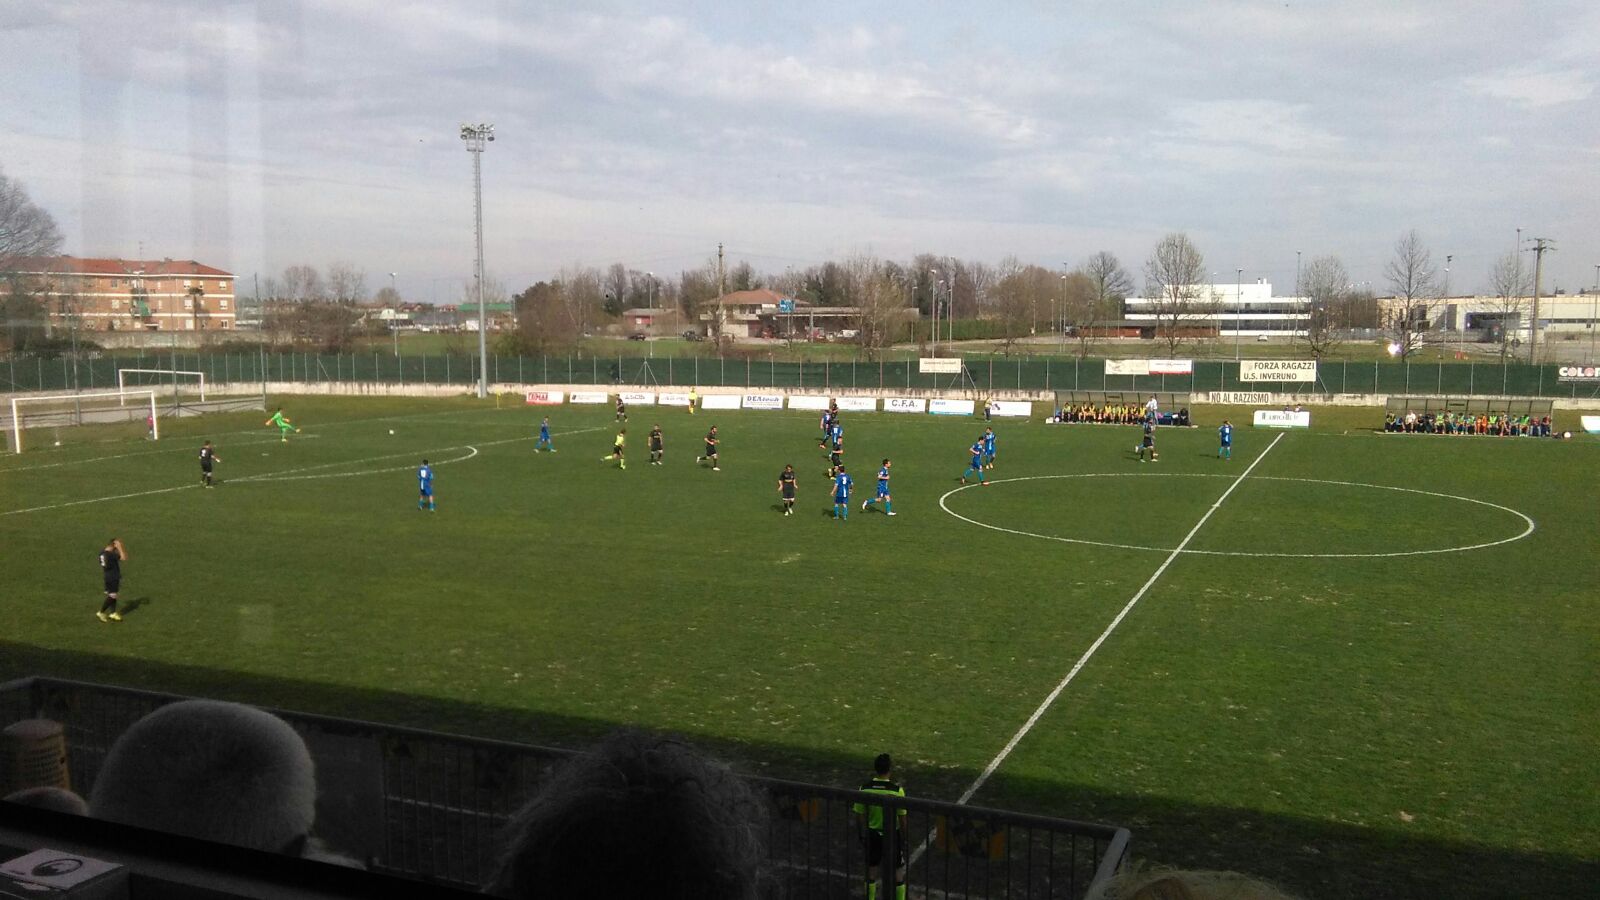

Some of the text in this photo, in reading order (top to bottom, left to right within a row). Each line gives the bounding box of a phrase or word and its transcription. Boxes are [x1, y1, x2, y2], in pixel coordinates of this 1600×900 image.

[1254, 362, 1315, 370] FORZA RAGAZZI
[1243, 372, 1297, 380] U.S. INVERUNO
[1211, 391, 1269, 404] NO AL RAZZISMO
[891, 399, 918, 408] C.F.A.
